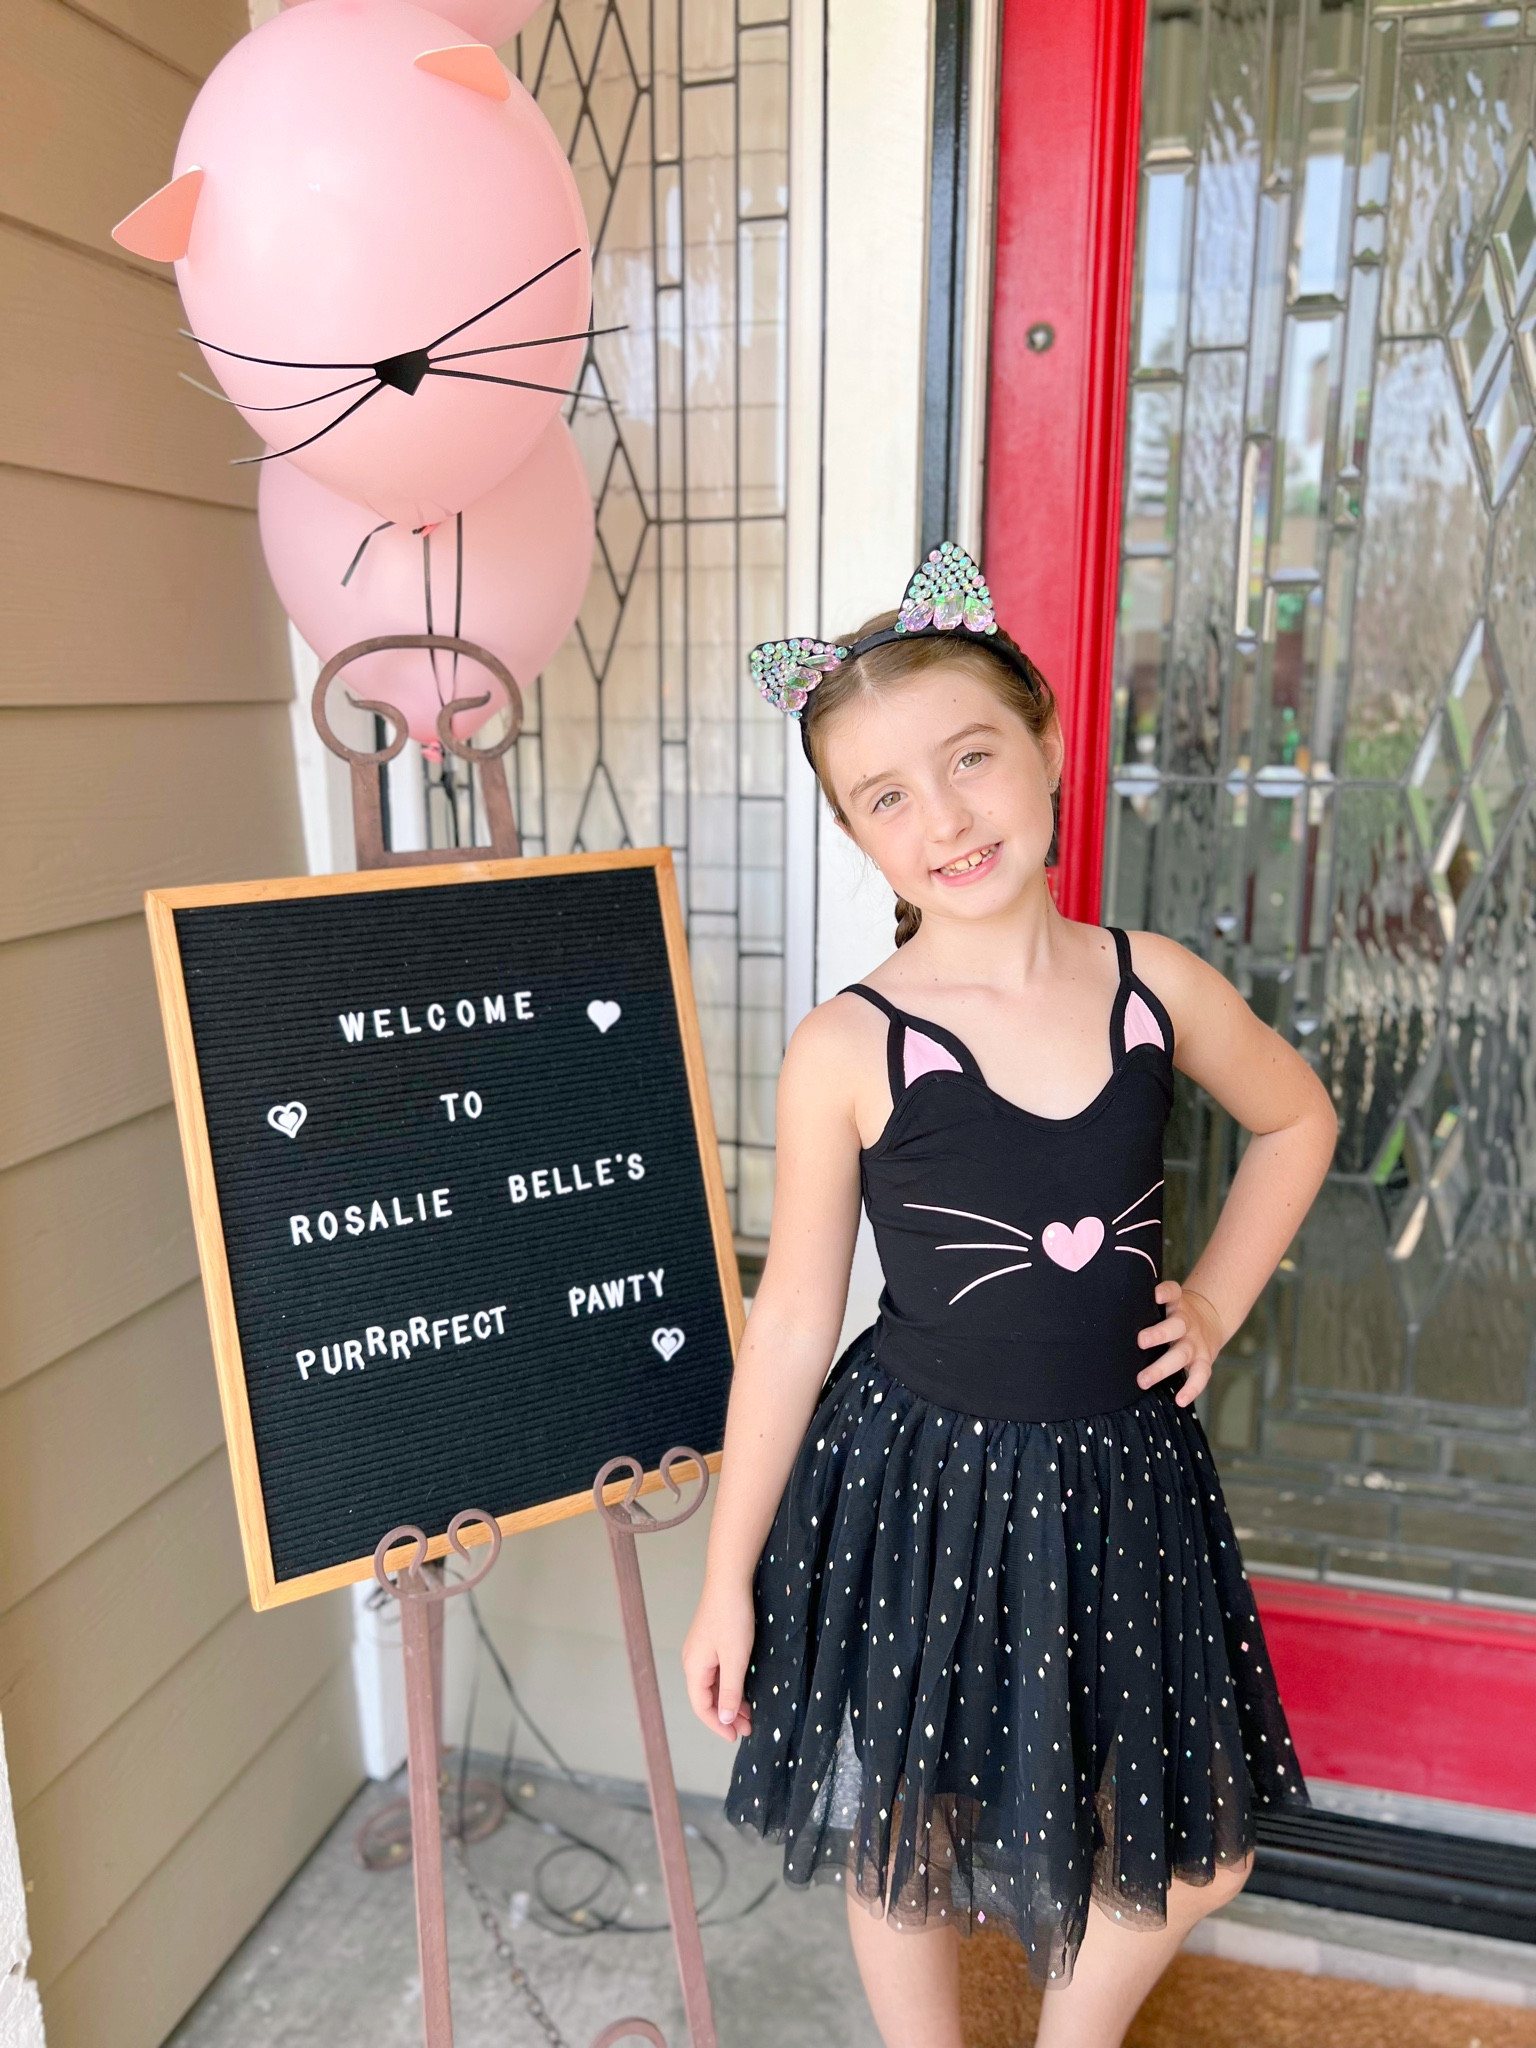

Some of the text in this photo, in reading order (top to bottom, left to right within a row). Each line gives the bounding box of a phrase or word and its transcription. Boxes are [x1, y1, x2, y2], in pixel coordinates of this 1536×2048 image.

[338, 990, 536, 1043] WELCOME
[439, 1090, 483, 1122] TO
[289, 1153, 645, 1246] ROSALIE BELLE'S
[295, 1267, 666, 1381] PURRRRFECT PAWTY
